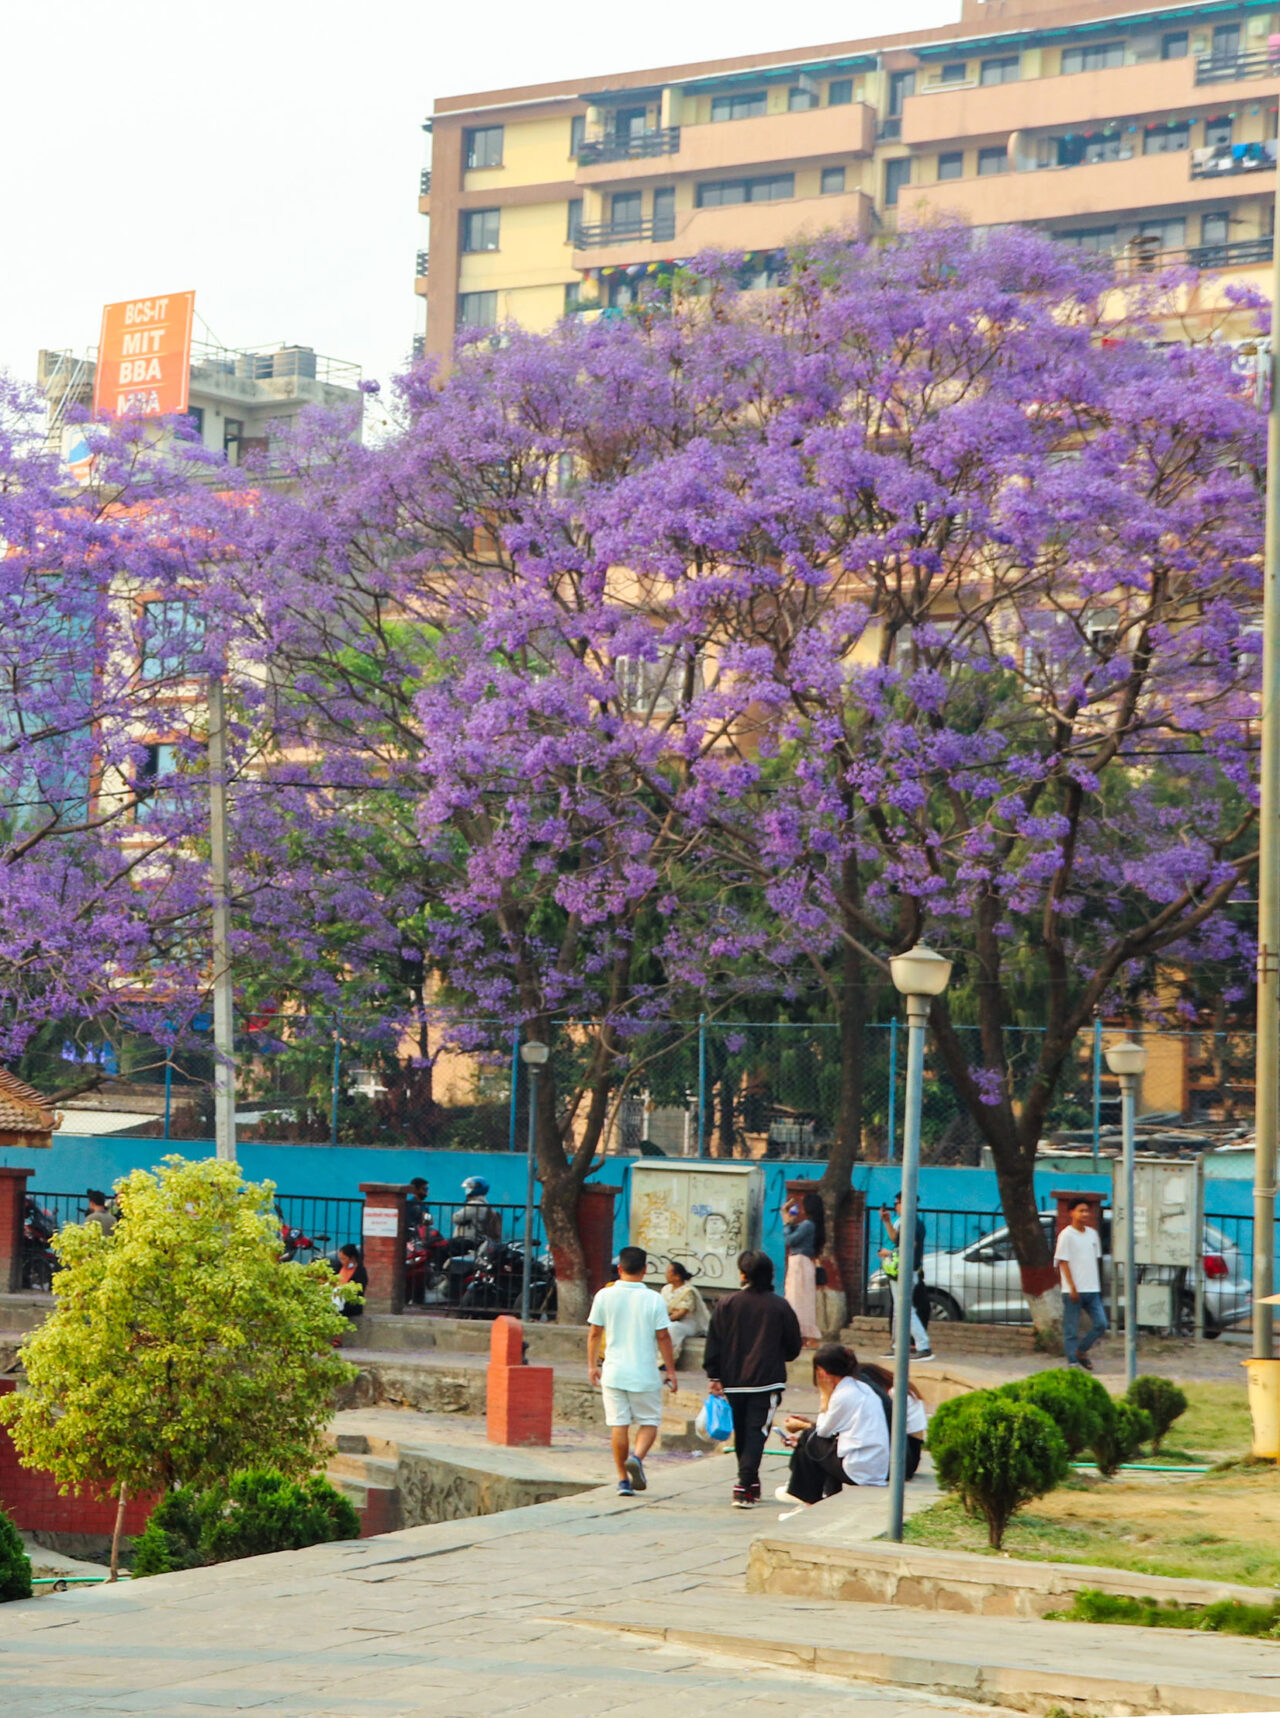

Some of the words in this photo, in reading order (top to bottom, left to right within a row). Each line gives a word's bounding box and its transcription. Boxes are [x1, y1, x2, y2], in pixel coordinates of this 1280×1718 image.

[124, 297, 169, 325] BCS-IT
[121, 328, 166, 356] MIT
[118, 357, 162, 385] BBA
